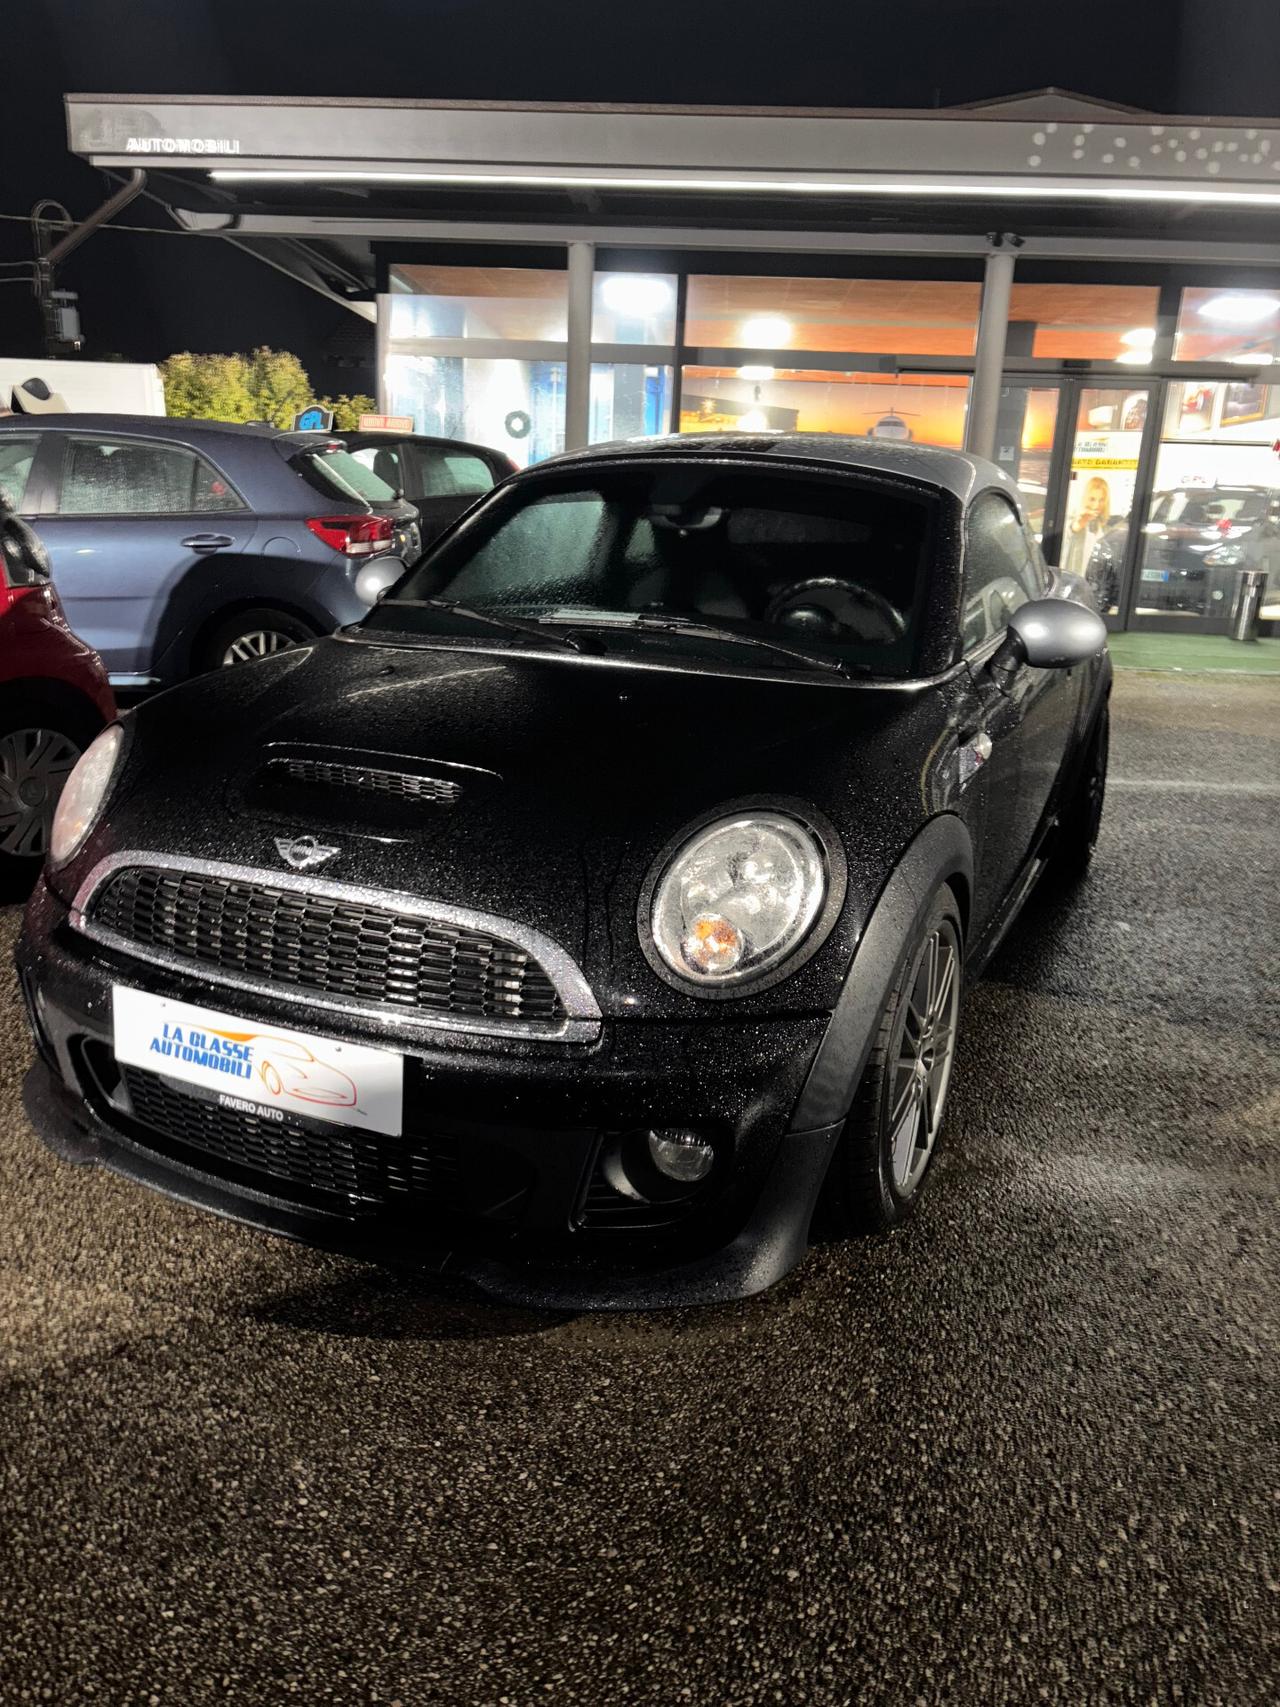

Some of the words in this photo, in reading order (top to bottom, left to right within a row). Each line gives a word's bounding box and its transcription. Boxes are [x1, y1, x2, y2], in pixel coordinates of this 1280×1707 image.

[126, 137, 240, 154] AUTOMOBILI
[163, 1023, 183, 1043] LA
[150, 1037, 252, 1080] AUTOMOBILI
[219, 1094, 256, 1114] FAVERO
[257, 1105, 284, 1121] AUTO
